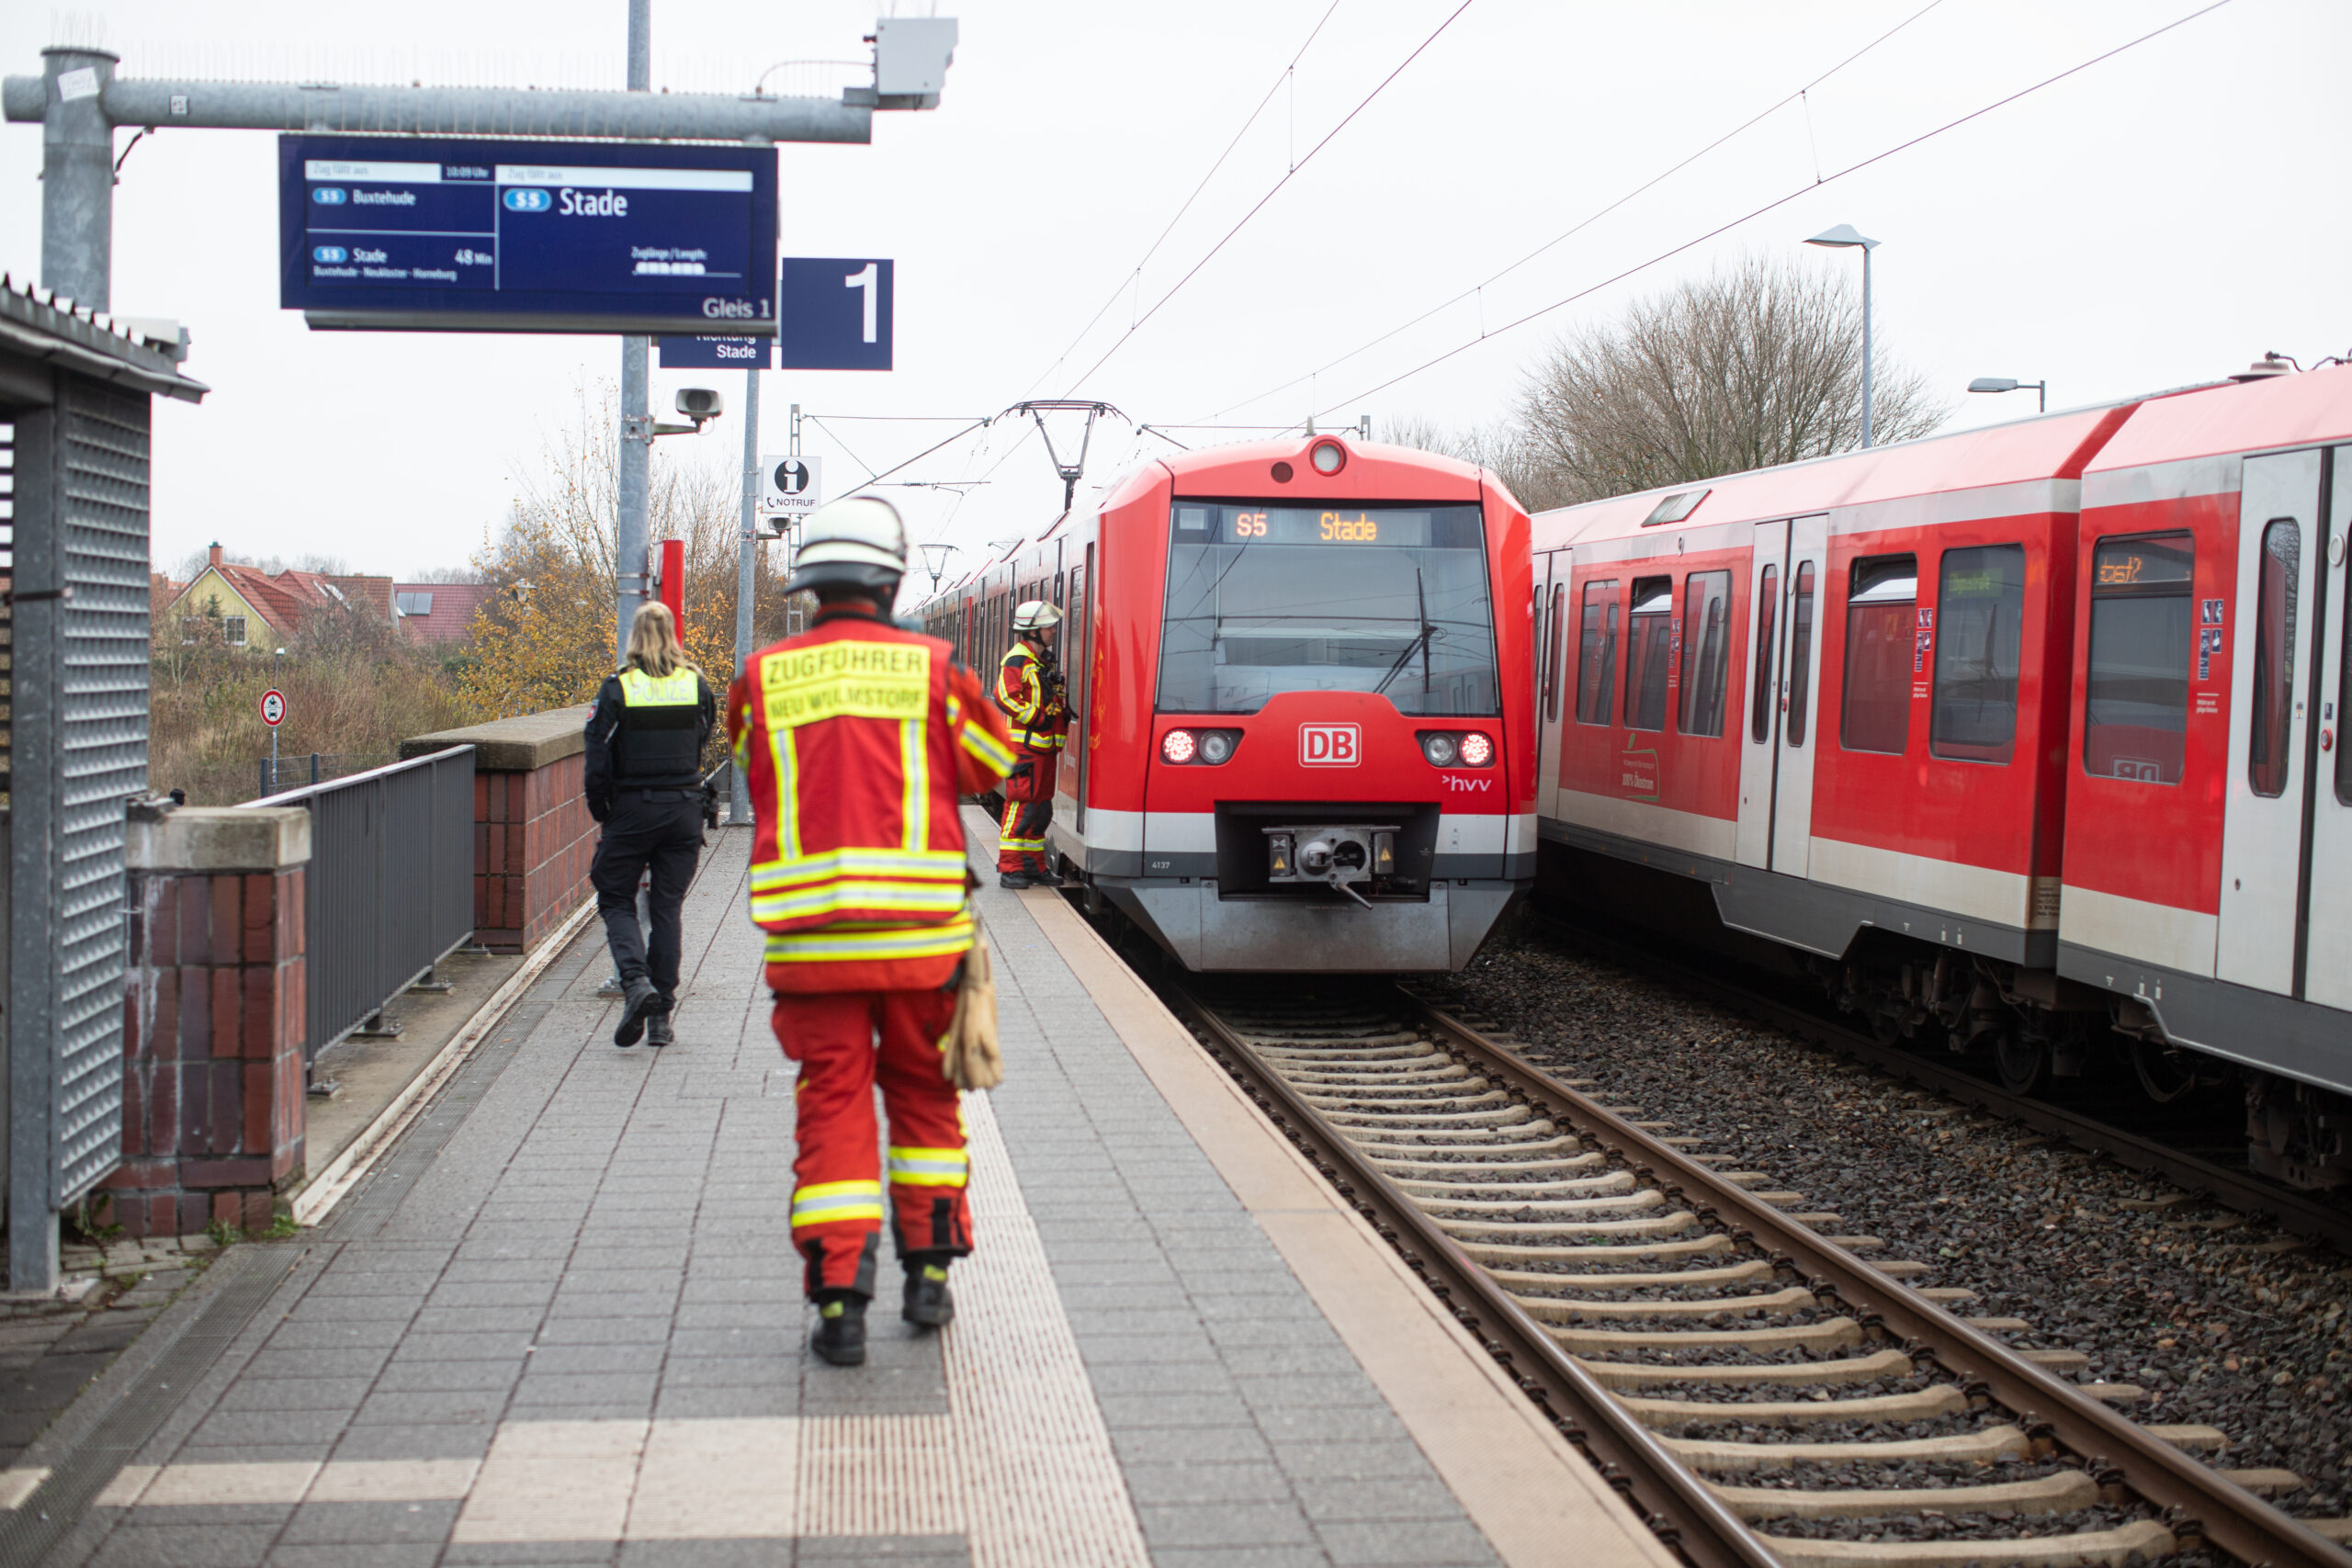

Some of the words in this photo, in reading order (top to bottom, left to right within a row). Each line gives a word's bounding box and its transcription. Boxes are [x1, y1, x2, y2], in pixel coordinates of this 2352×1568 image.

[472, 166, 490, 178] Uhr
[353, 189, 416, 206] Buxtehude
[559, 187, 628, 217] Stade
[353, 248, 388, 264] Stade
[455, 249, 473, 265] 48
[313, 265, 358, 277] Buxtehude
[703, 298, 753, 319] Gleis
[760, 299, 771, 319] 1
[845, 263, 877, 343] 1
[717, 344, 756, 358] Stade
[776, 498, 815, 507] NOTRUF
[1237, 513, 1267, 536] S5
[1320, 513, 1377, 540] Stade
[632, 682, 694, 703] POLIZEI
[770, 695, 804, 718] NEU
[1307, 731, 1353, 759] DB
[1451, 775, 1492, 792] hvv
[1152, 861, 1170, 869] 4137
